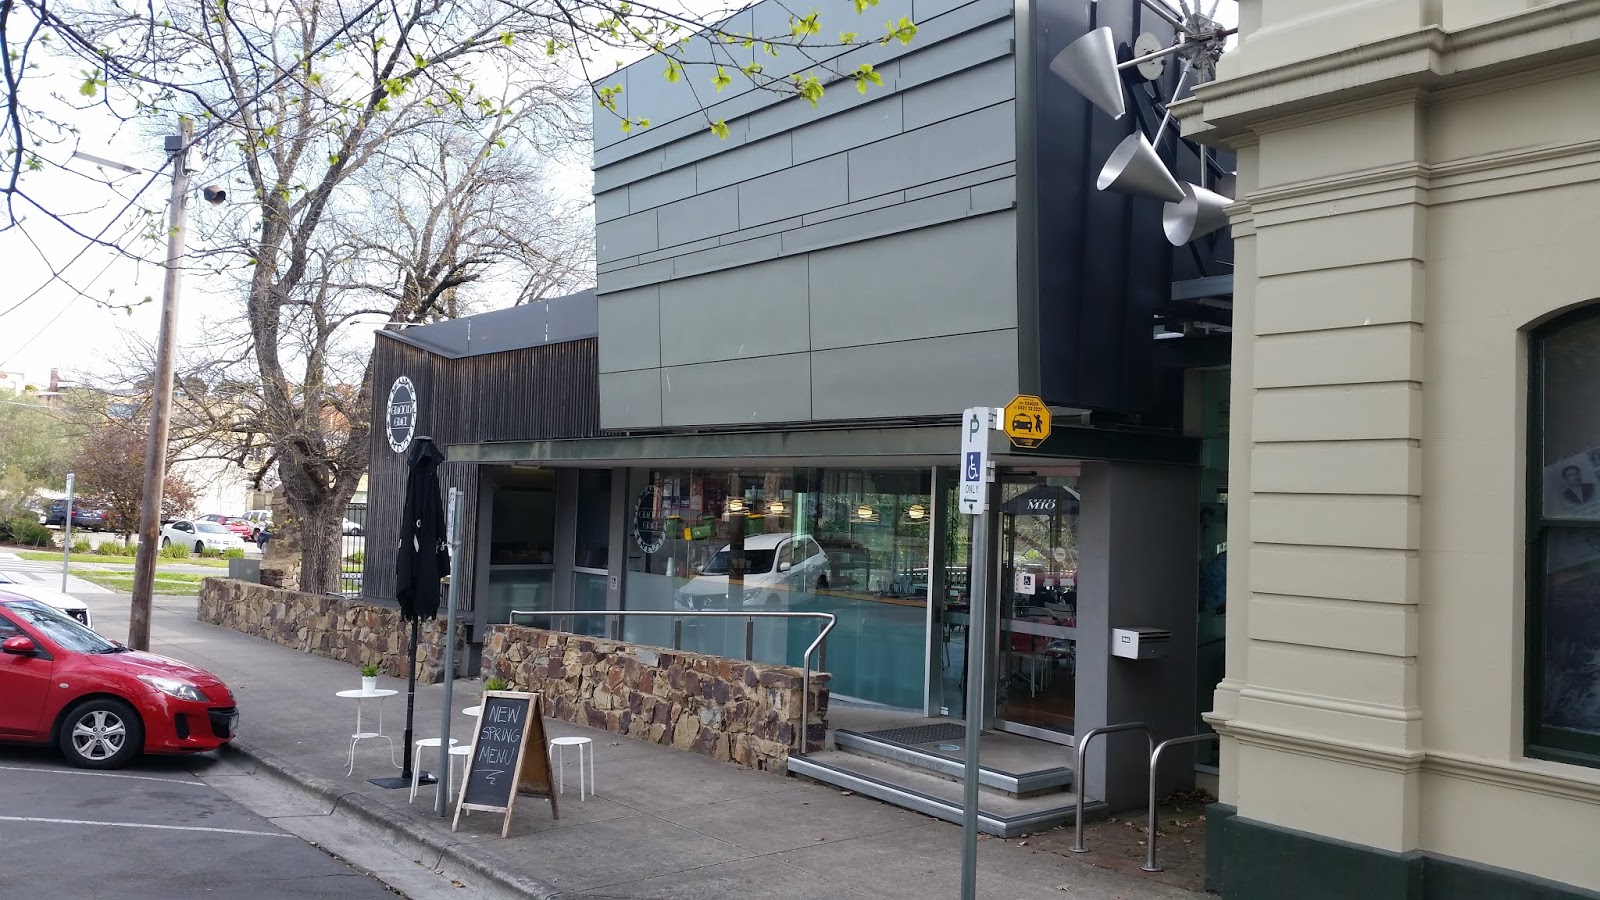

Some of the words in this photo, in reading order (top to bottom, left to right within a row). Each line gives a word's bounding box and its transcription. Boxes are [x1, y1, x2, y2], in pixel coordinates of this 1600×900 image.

[969, 418, 980, 443] P
[965, 484, 980, 494] ONLY
[1027, 501, 1056, 510] MIO
[488, 705, 521, 724] NEW
[481, 726, 520, 743] SPRING
[478, 746, 515, 766] MENU
